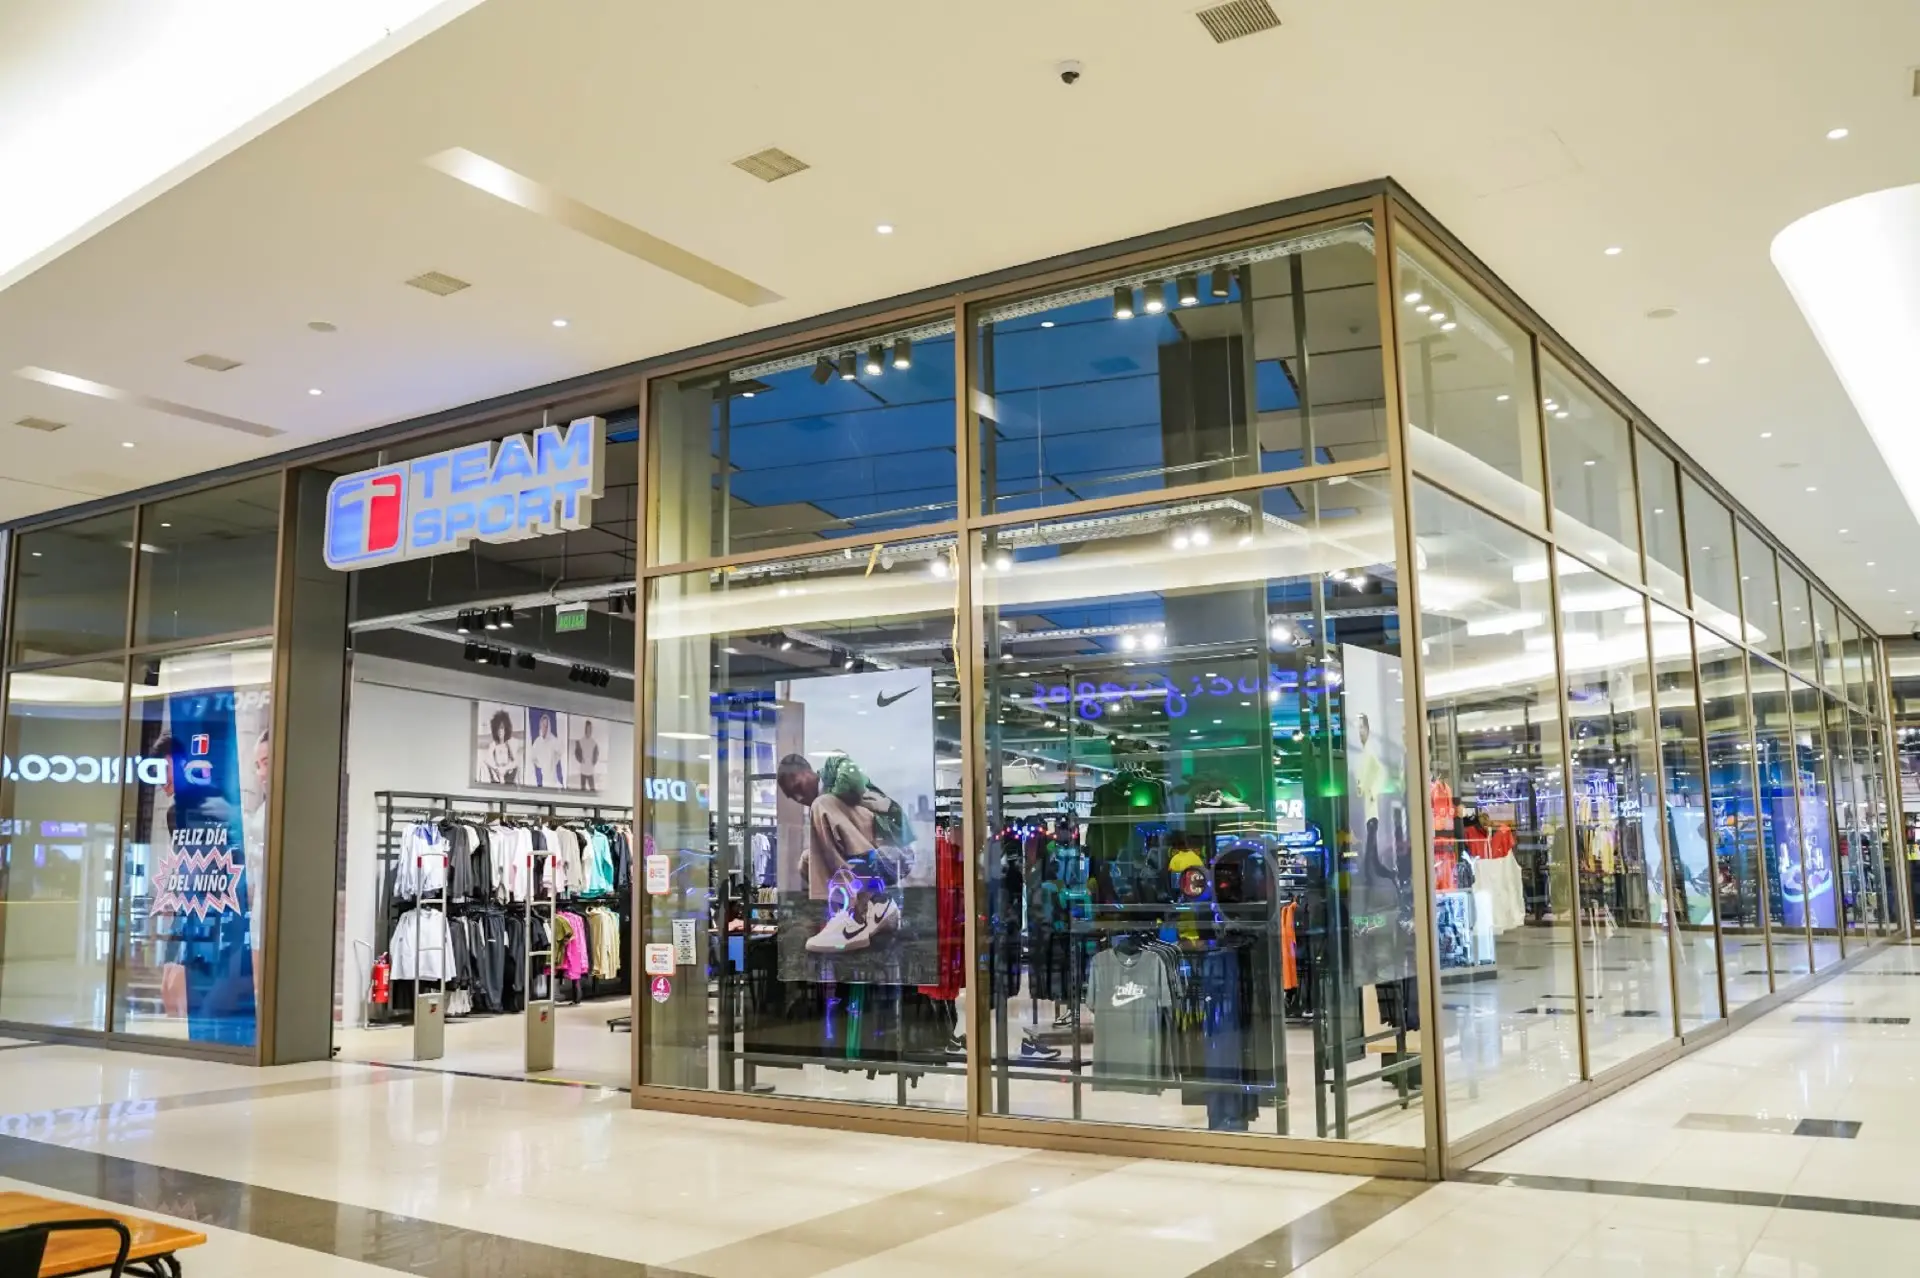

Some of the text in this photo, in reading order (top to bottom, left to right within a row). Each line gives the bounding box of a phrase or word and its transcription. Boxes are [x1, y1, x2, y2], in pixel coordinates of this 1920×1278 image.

[412, 422, 592, 498] TEAM
[411, 478, 589, 549] SPORT
[171, 823, 228, 846] FELIZ DÍA
[167, 869, 228, 892] DEL NIÑO
[656, 978, 665, 990] 4
